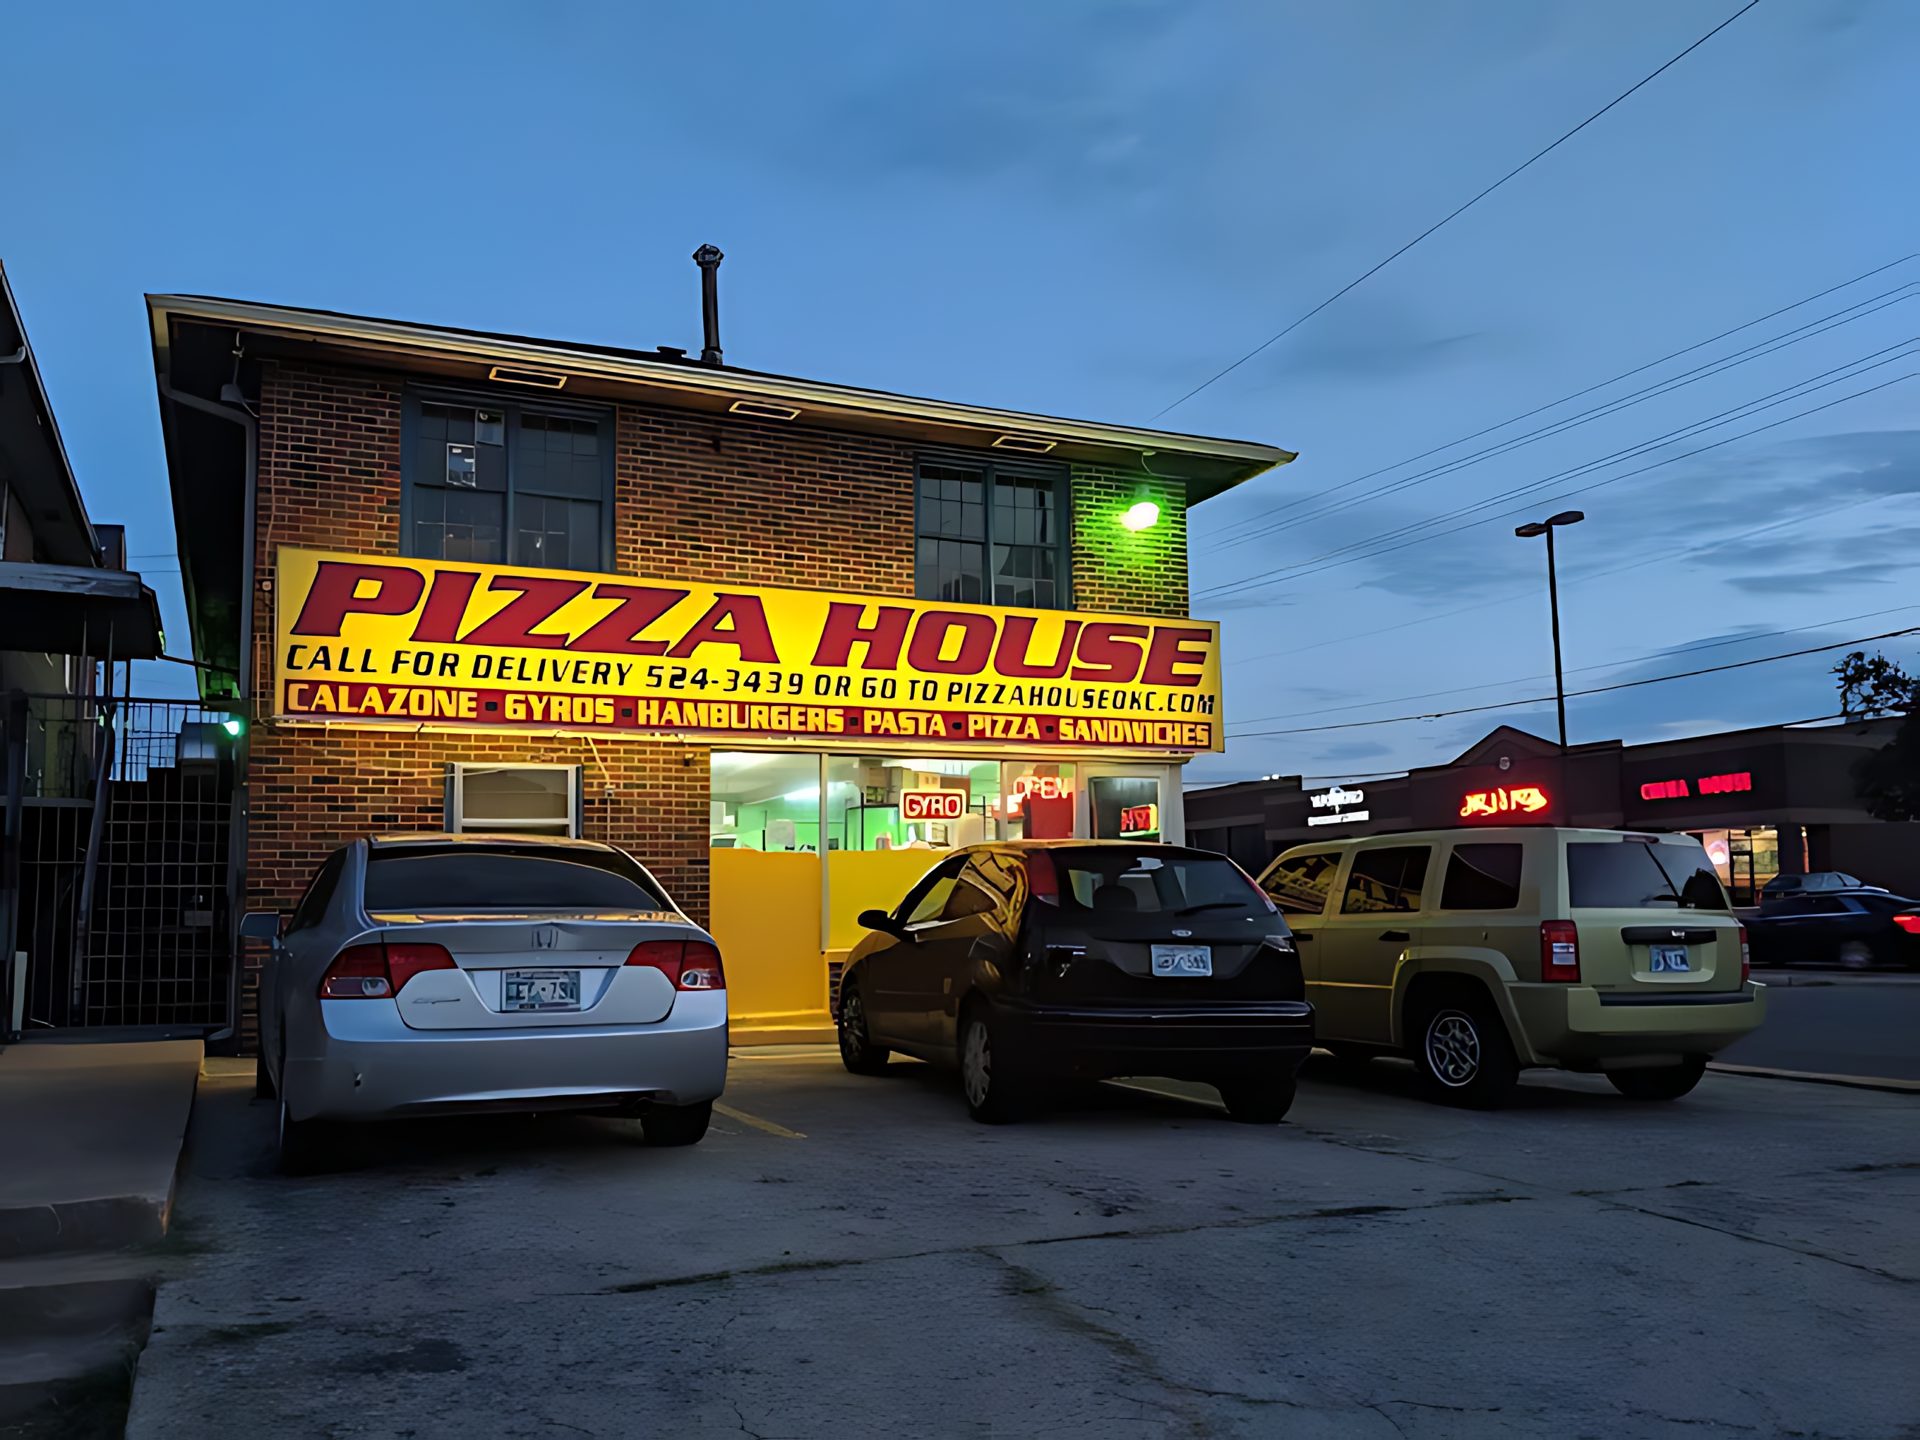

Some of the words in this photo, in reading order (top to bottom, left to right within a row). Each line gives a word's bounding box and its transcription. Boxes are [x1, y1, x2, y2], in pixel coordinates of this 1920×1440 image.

[290, 560, 780, 663] PIZZA
[811, 602, 1213, 687] HOUSE
[286, 644, 377, 673] CALL
[391, 650, 460, 677] FOR
[471, 654, 633, 686] DELIVERY
[646, 665, 804, 695] 524-3439
[814, 674, 851, 697] OR
[861, 677, 897, 699] GO
[909, 679, 938, 701] TO
[947, 682, 1215, 714] PIZZAHOUSEOKC.COM
[288, 683, 478, 718] CALAZONE
[505, 693, 615, 724] GYROS
[637, 699, 845, 733] HAMBURGERS
[864, 709, 947, 736] PASTA
[968, 714, 1041, 739] PIZZA
[1059, 718, 1210, 746] SANDWICHES
[905, 794, 961, 817] GYRO
[1013, 776, 1075, 800] OPEN
